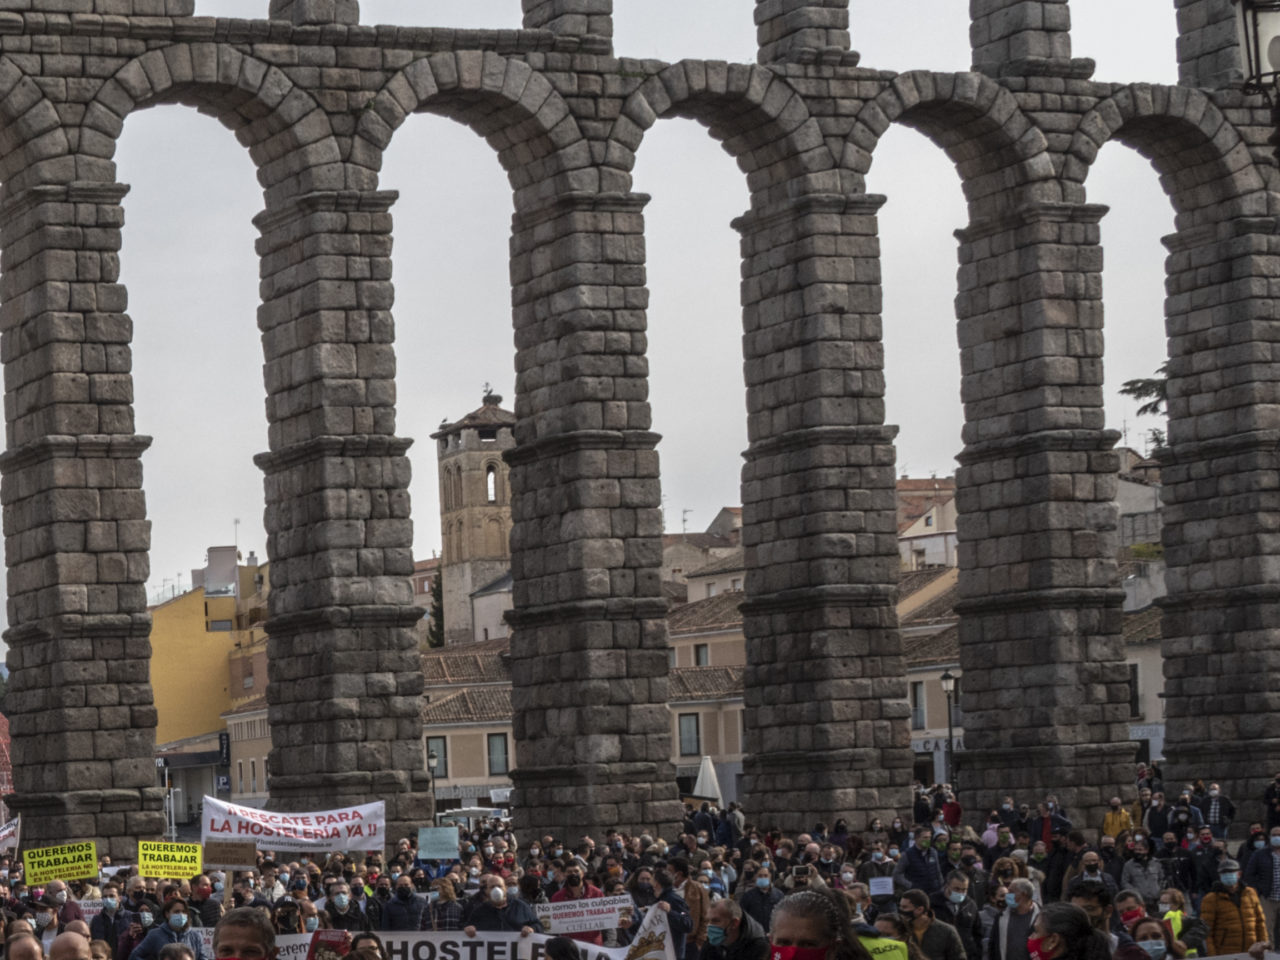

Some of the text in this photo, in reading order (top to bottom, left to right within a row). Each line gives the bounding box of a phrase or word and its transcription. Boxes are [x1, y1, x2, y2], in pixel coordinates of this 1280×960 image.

[240, 809, 312, 826] RESCATE
[315, 810, 364, 826] PARA
[210, 818, 232, 833] LA
[237, 820, 341, 840] HOSTELERÍA
[346, 824, 364, 837] YA
[28, 842, 92, 859] QUEREMOS
[142, 843, 198, 854] QUEREMOS
[28, 853, 92, 870] TRABAJAR
[142, 853, 197, 864] TRABAJAR
[54, 870, 90, 880] PROBLEMA
[592, 897, 629, 907] culpables
[552, 907, 616, 920] QUEREMOS TRABAJAR
